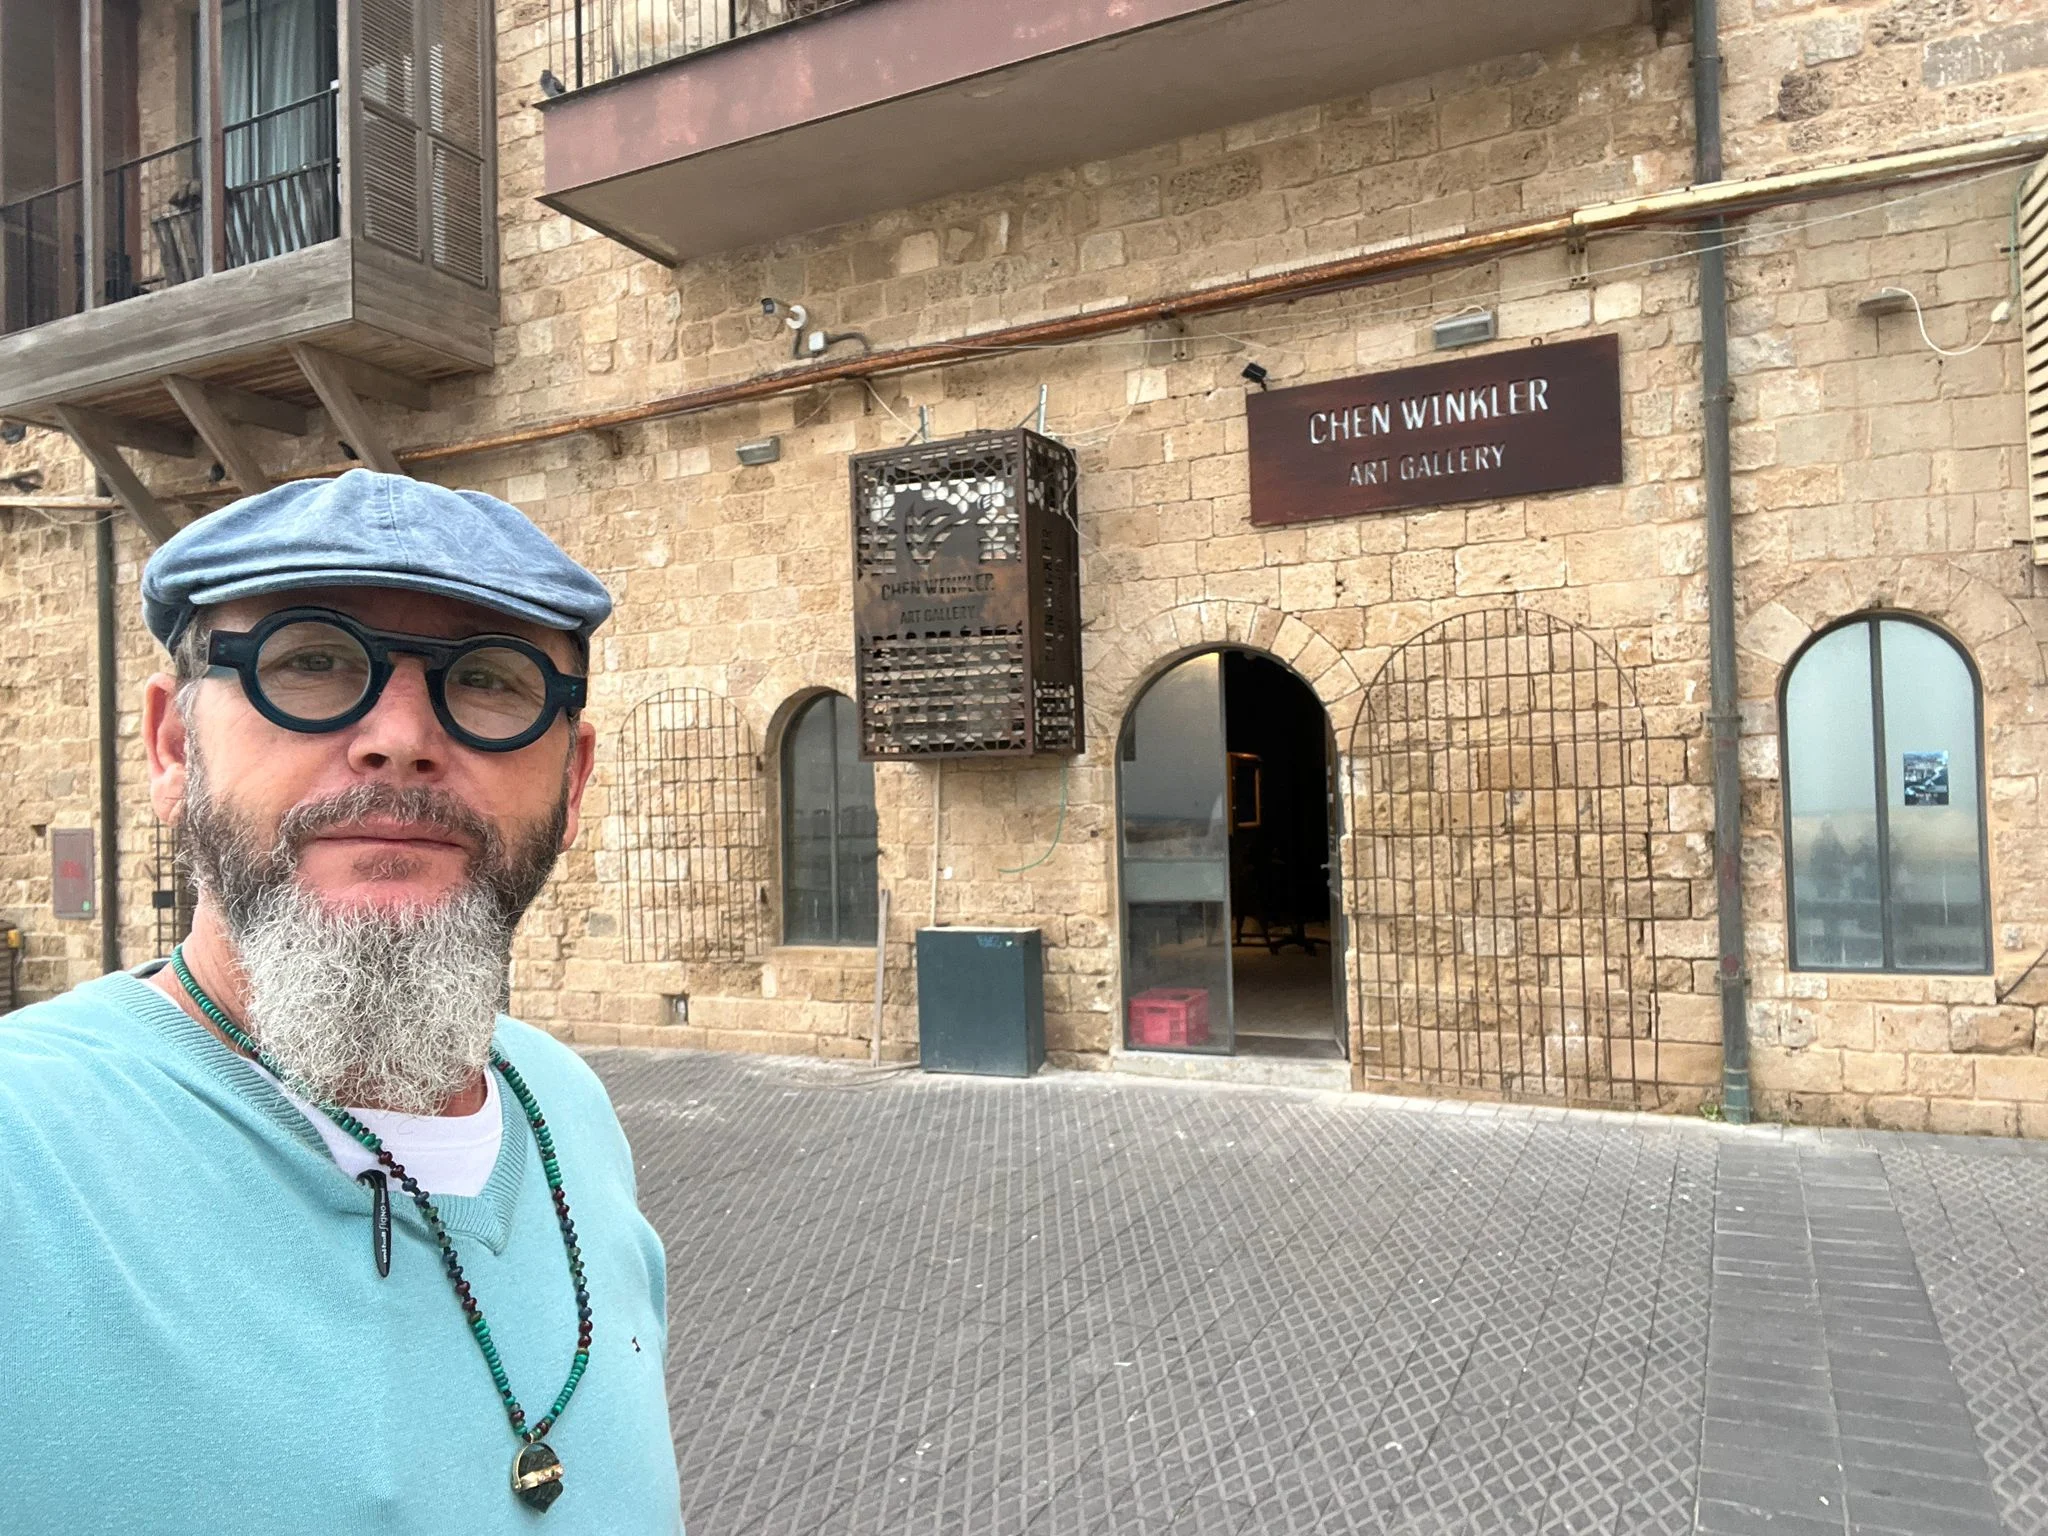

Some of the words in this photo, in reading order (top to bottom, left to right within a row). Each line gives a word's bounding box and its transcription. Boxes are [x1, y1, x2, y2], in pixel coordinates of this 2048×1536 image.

[1309, 402, 1391, 446] CHEN
[1400, 378, 1549, 431] WINKLER
[1348, 458, 1390, 487] ART
[1400, 442, 1506, 481] GALLERY
[881, 580, 920, 601] CHEN
[900, 609, 921, 624] ART
[924, 605, 975, 622] GALLERY
